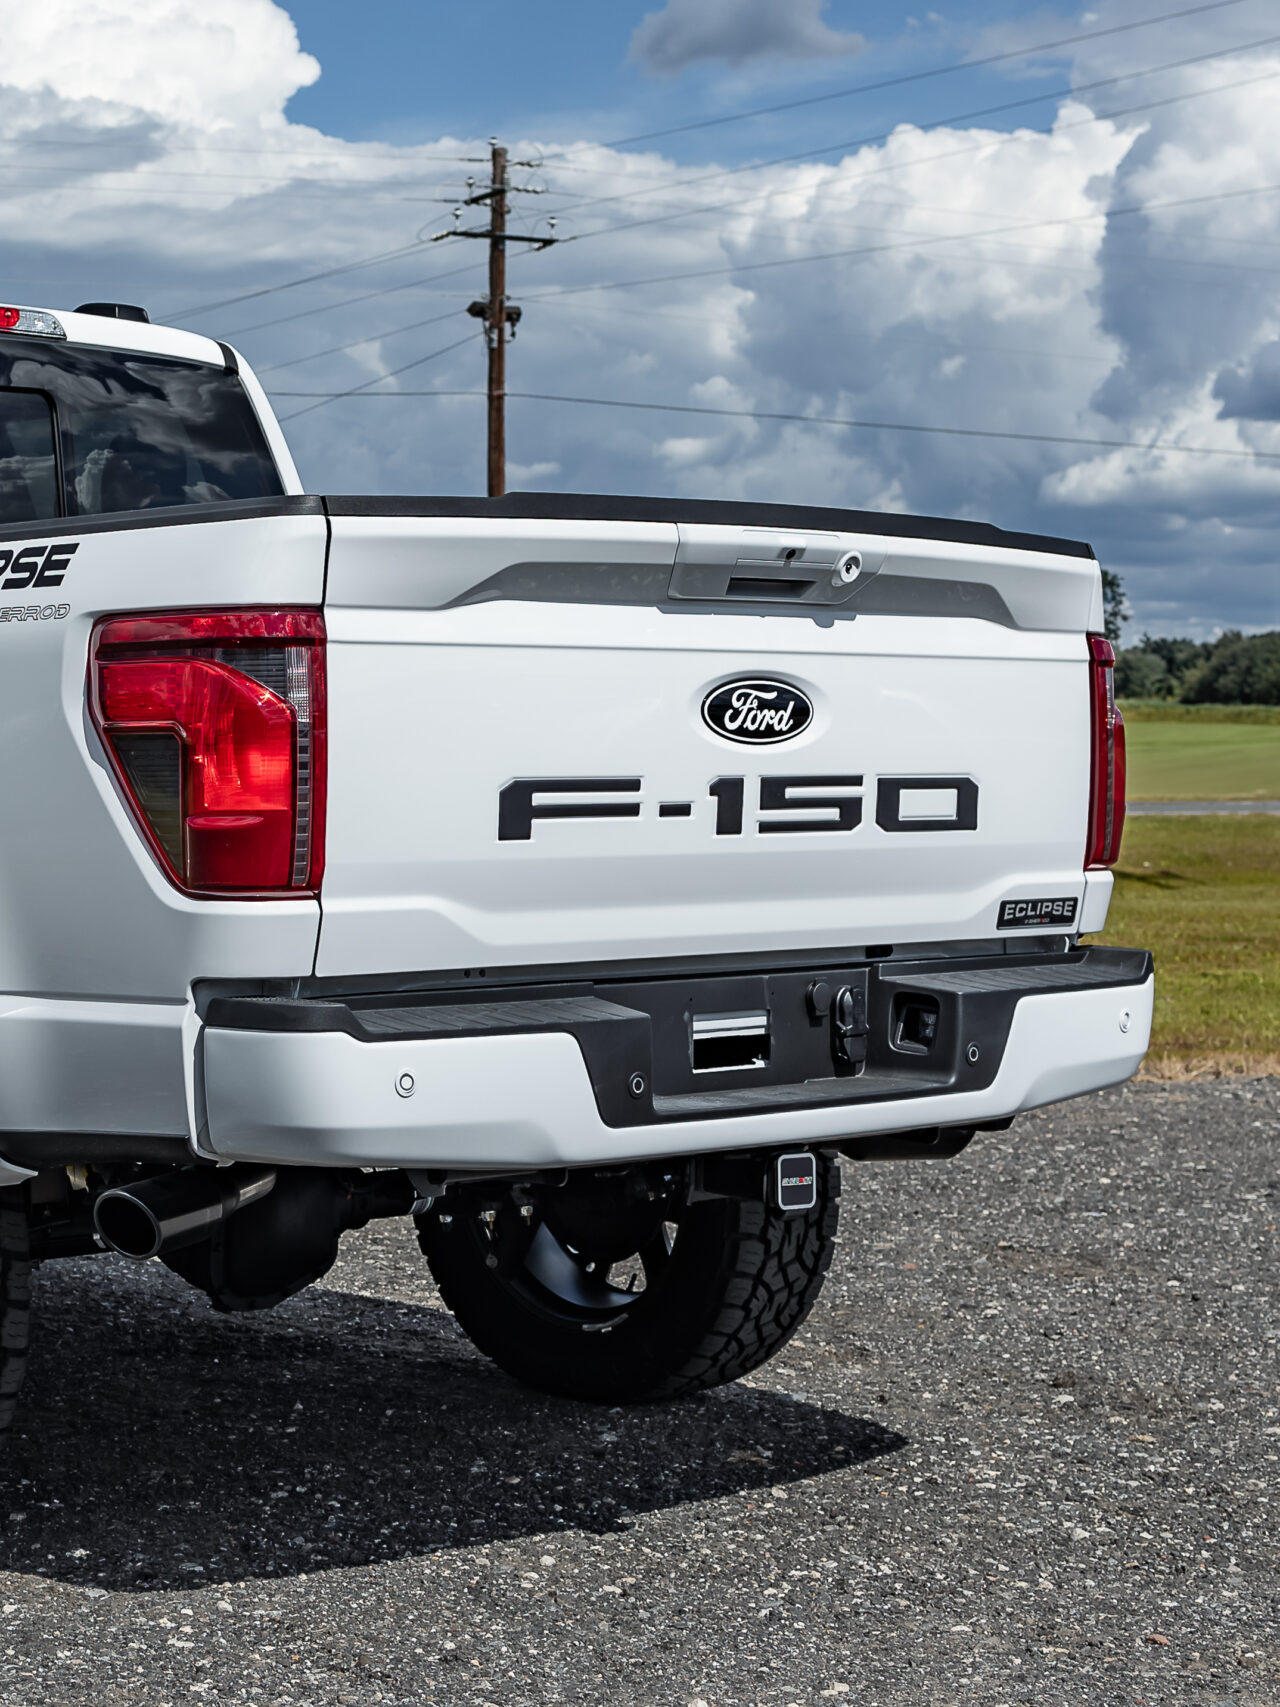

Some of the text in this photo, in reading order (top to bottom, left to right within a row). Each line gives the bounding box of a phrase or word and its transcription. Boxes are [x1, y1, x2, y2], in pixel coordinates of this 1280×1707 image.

[723, 688, 794, 733] Ford
[498, 775, 979, 842] F-150
[1004, 901, 1074, 920] ECLIPSE
